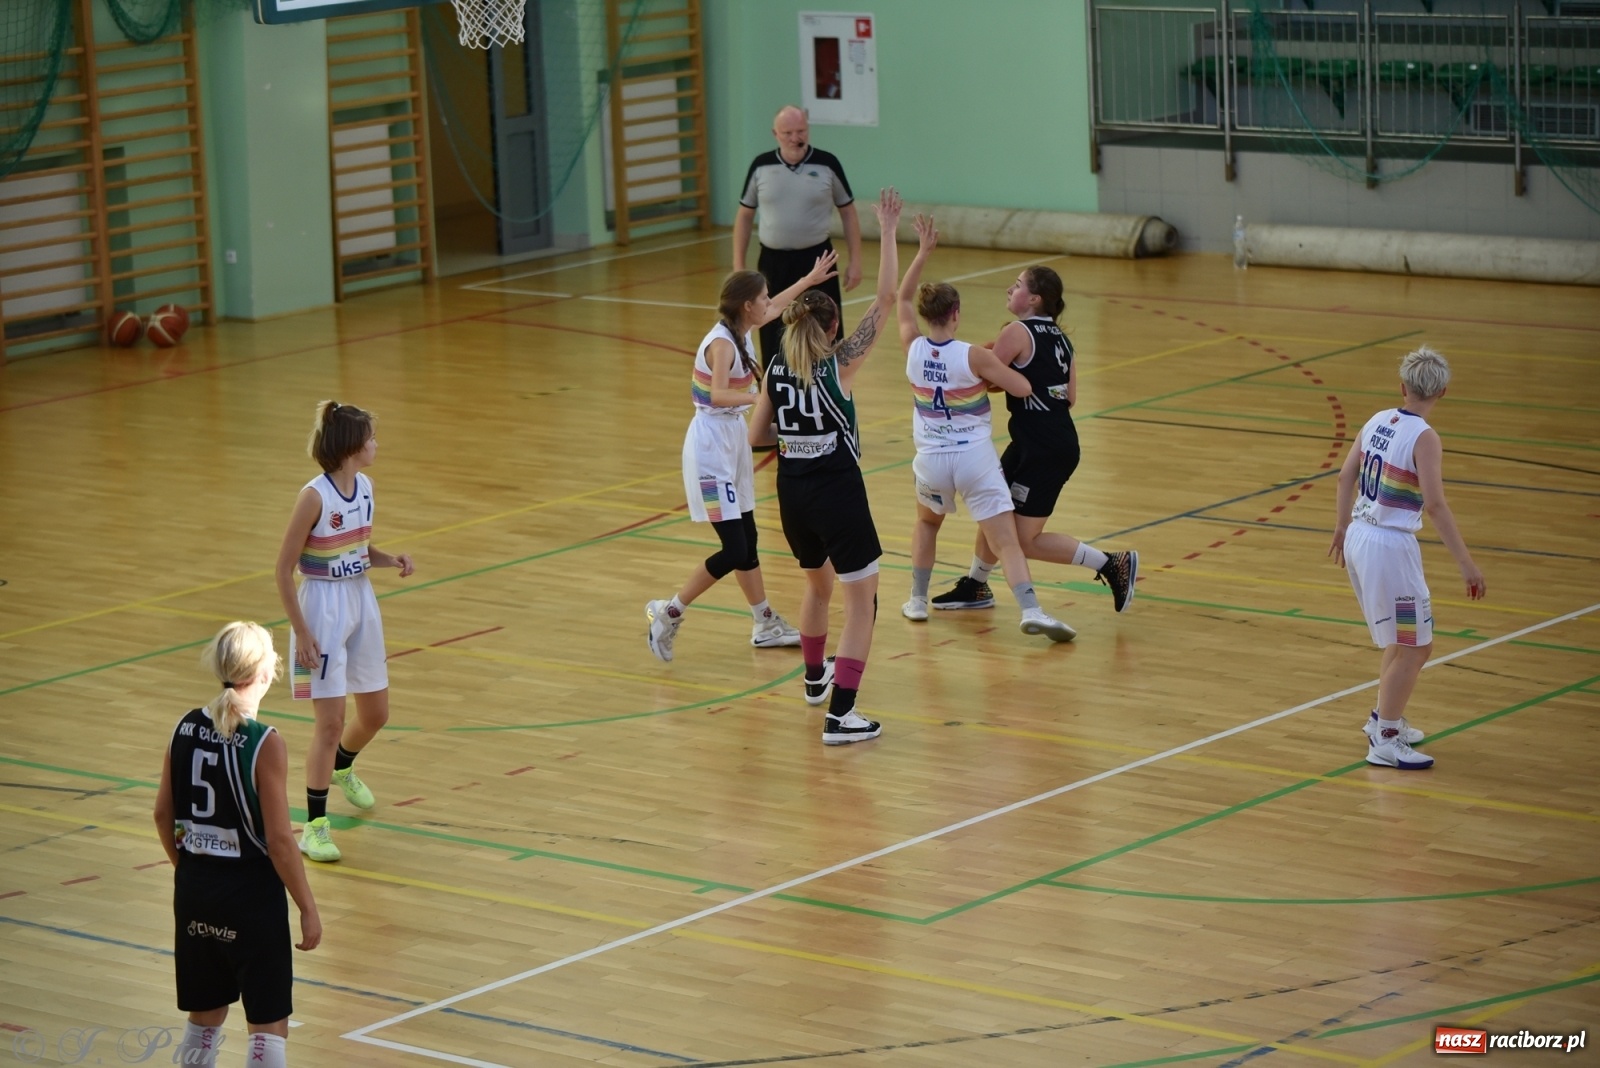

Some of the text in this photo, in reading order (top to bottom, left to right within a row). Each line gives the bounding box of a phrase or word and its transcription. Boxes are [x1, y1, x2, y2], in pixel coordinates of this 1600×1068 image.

[772, 364, 786, 376] RKK
[923, 369, 949, 384] POLSKA
[776, 382, 824, 431] 24
[932, 385, 952, 420] 4
[787, 441, 835, 455] WAGTECH
[1361, 450, 1383, 502] 10
[725, 482, 736, 504] 6
[363, 495, 371, 521] 7
[320, 653, 329, 680] 7
[179, 722, 197, 737] RKK
[191, 747, 219, 818] 5
